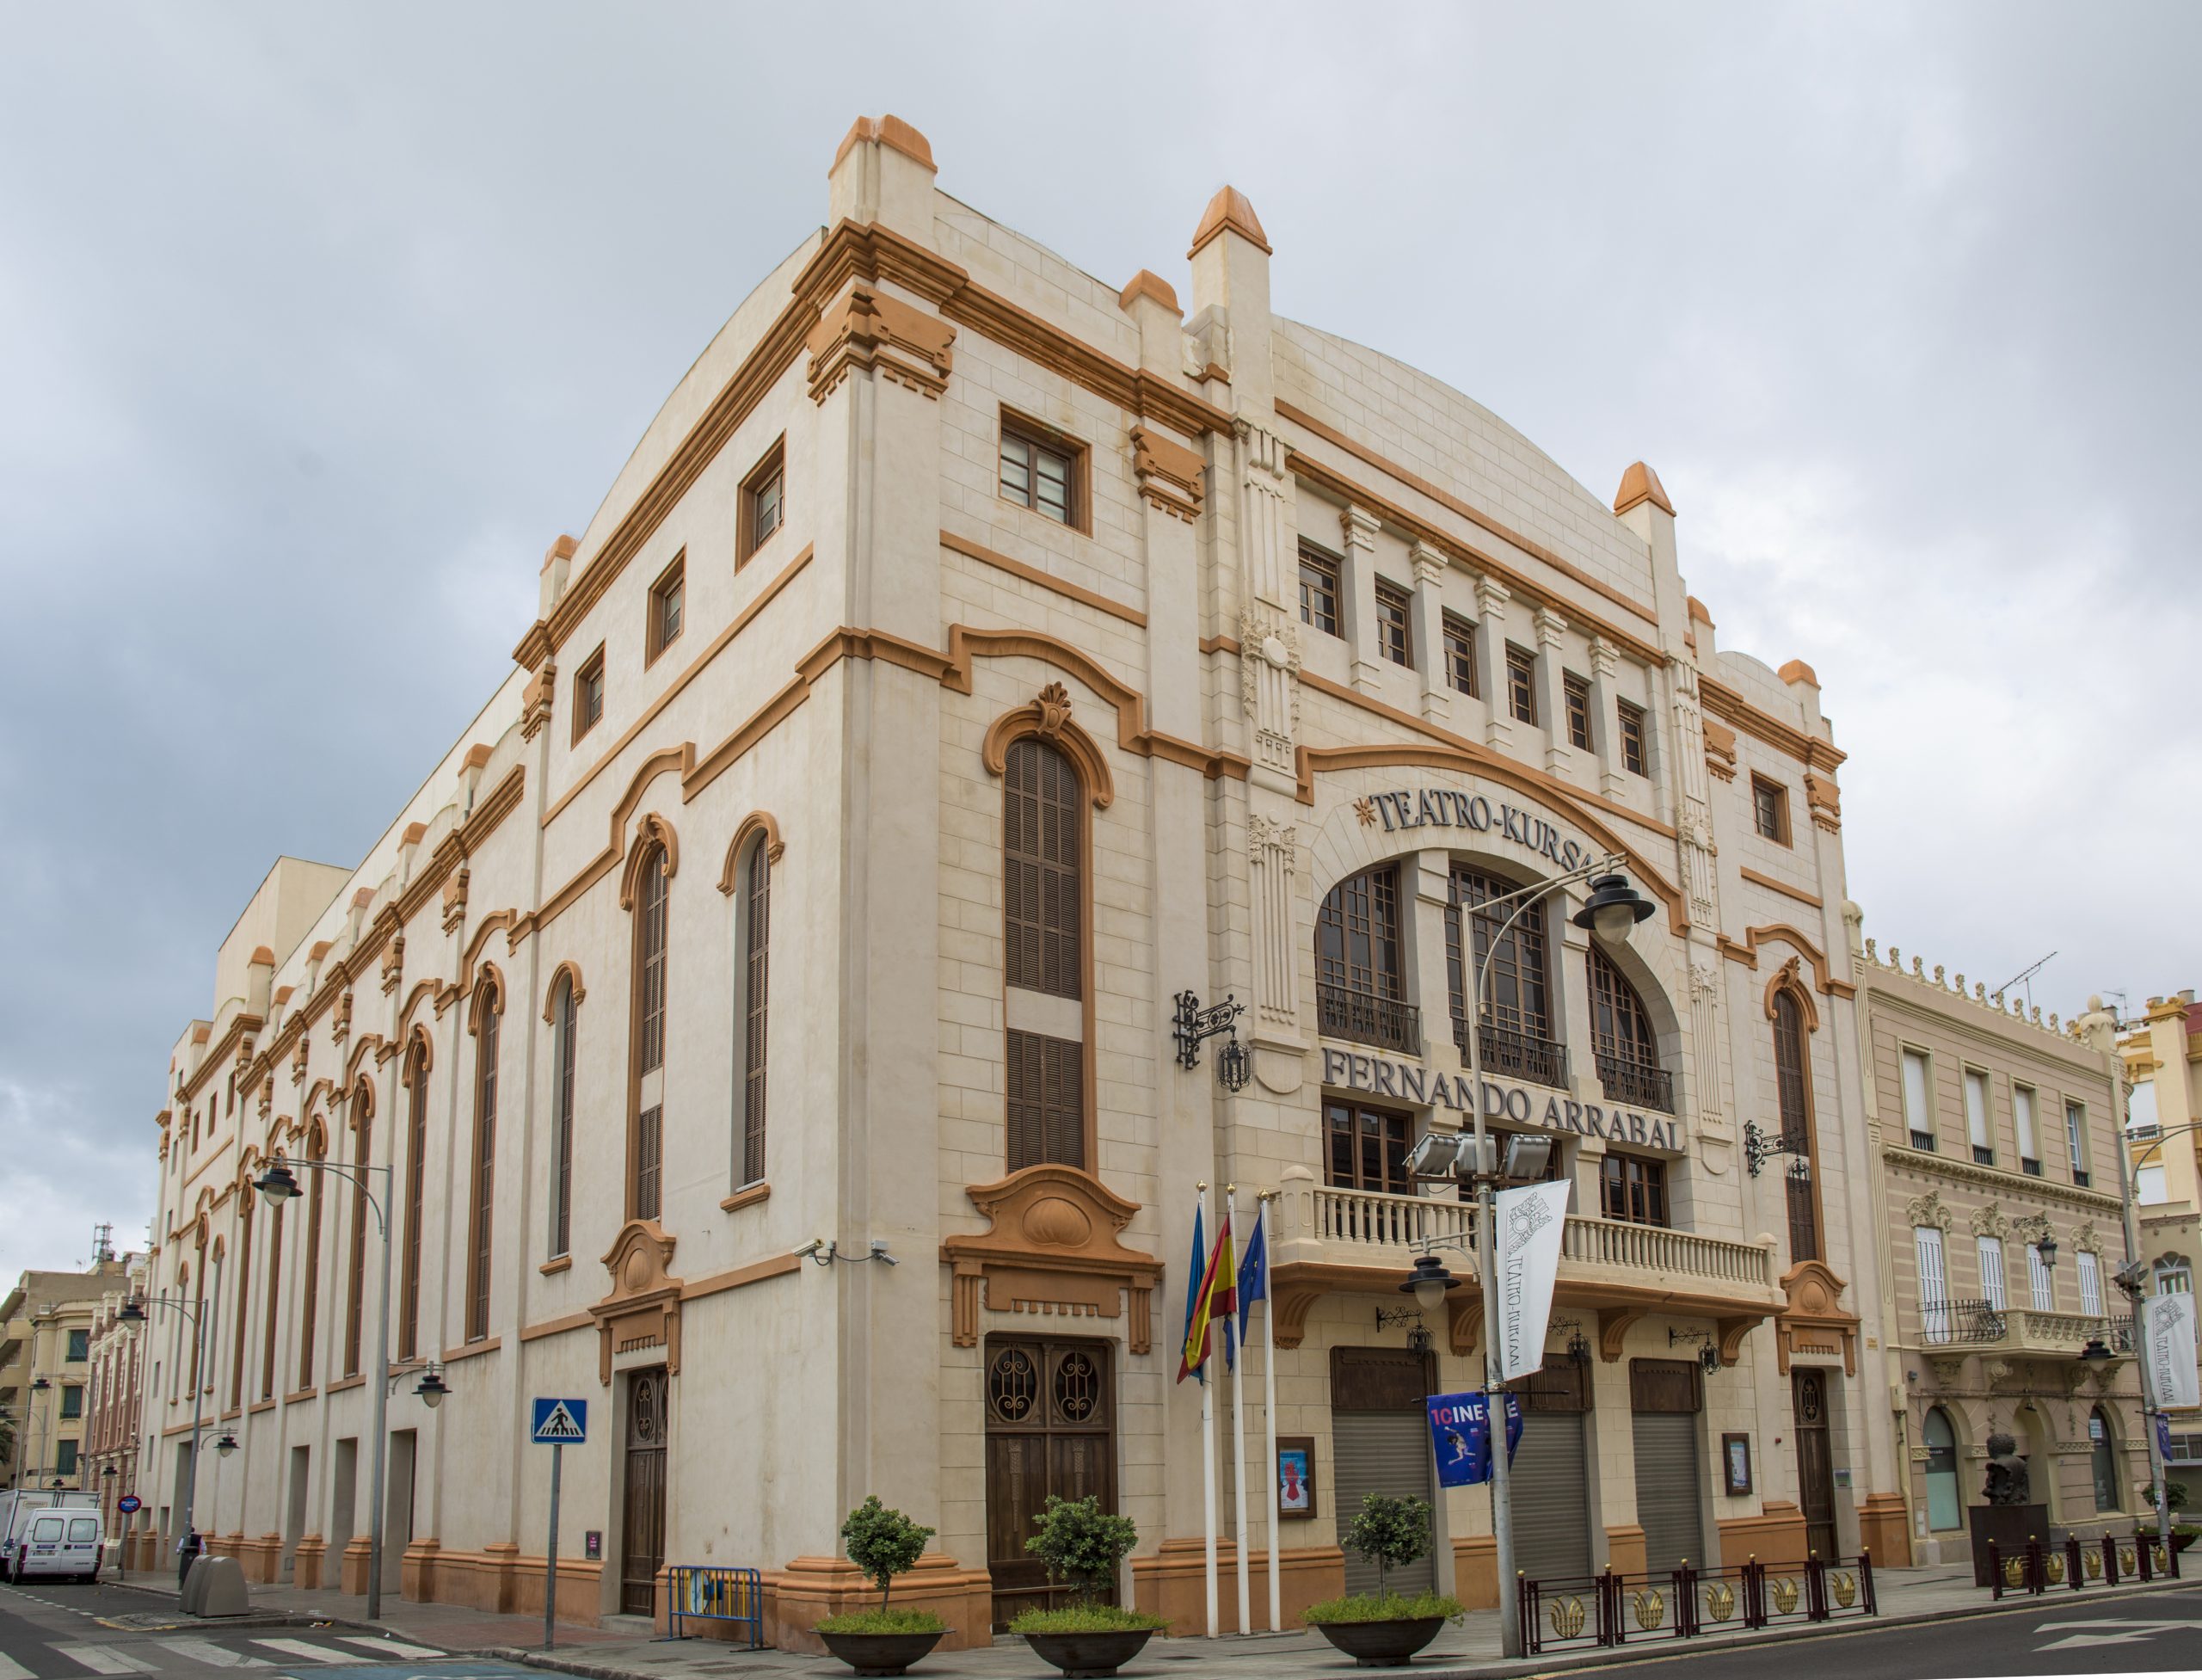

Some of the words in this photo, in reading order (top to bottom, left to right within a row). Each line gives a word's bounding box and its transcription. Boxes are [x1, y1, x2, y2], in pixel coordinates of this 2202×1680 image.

[1369, 789, 1593, 887] TEATRO-KURSA
[1322, 1047, 1532, 1122] FERNANDO
[1541, 1096, 1686, 1154] ARRABAL
